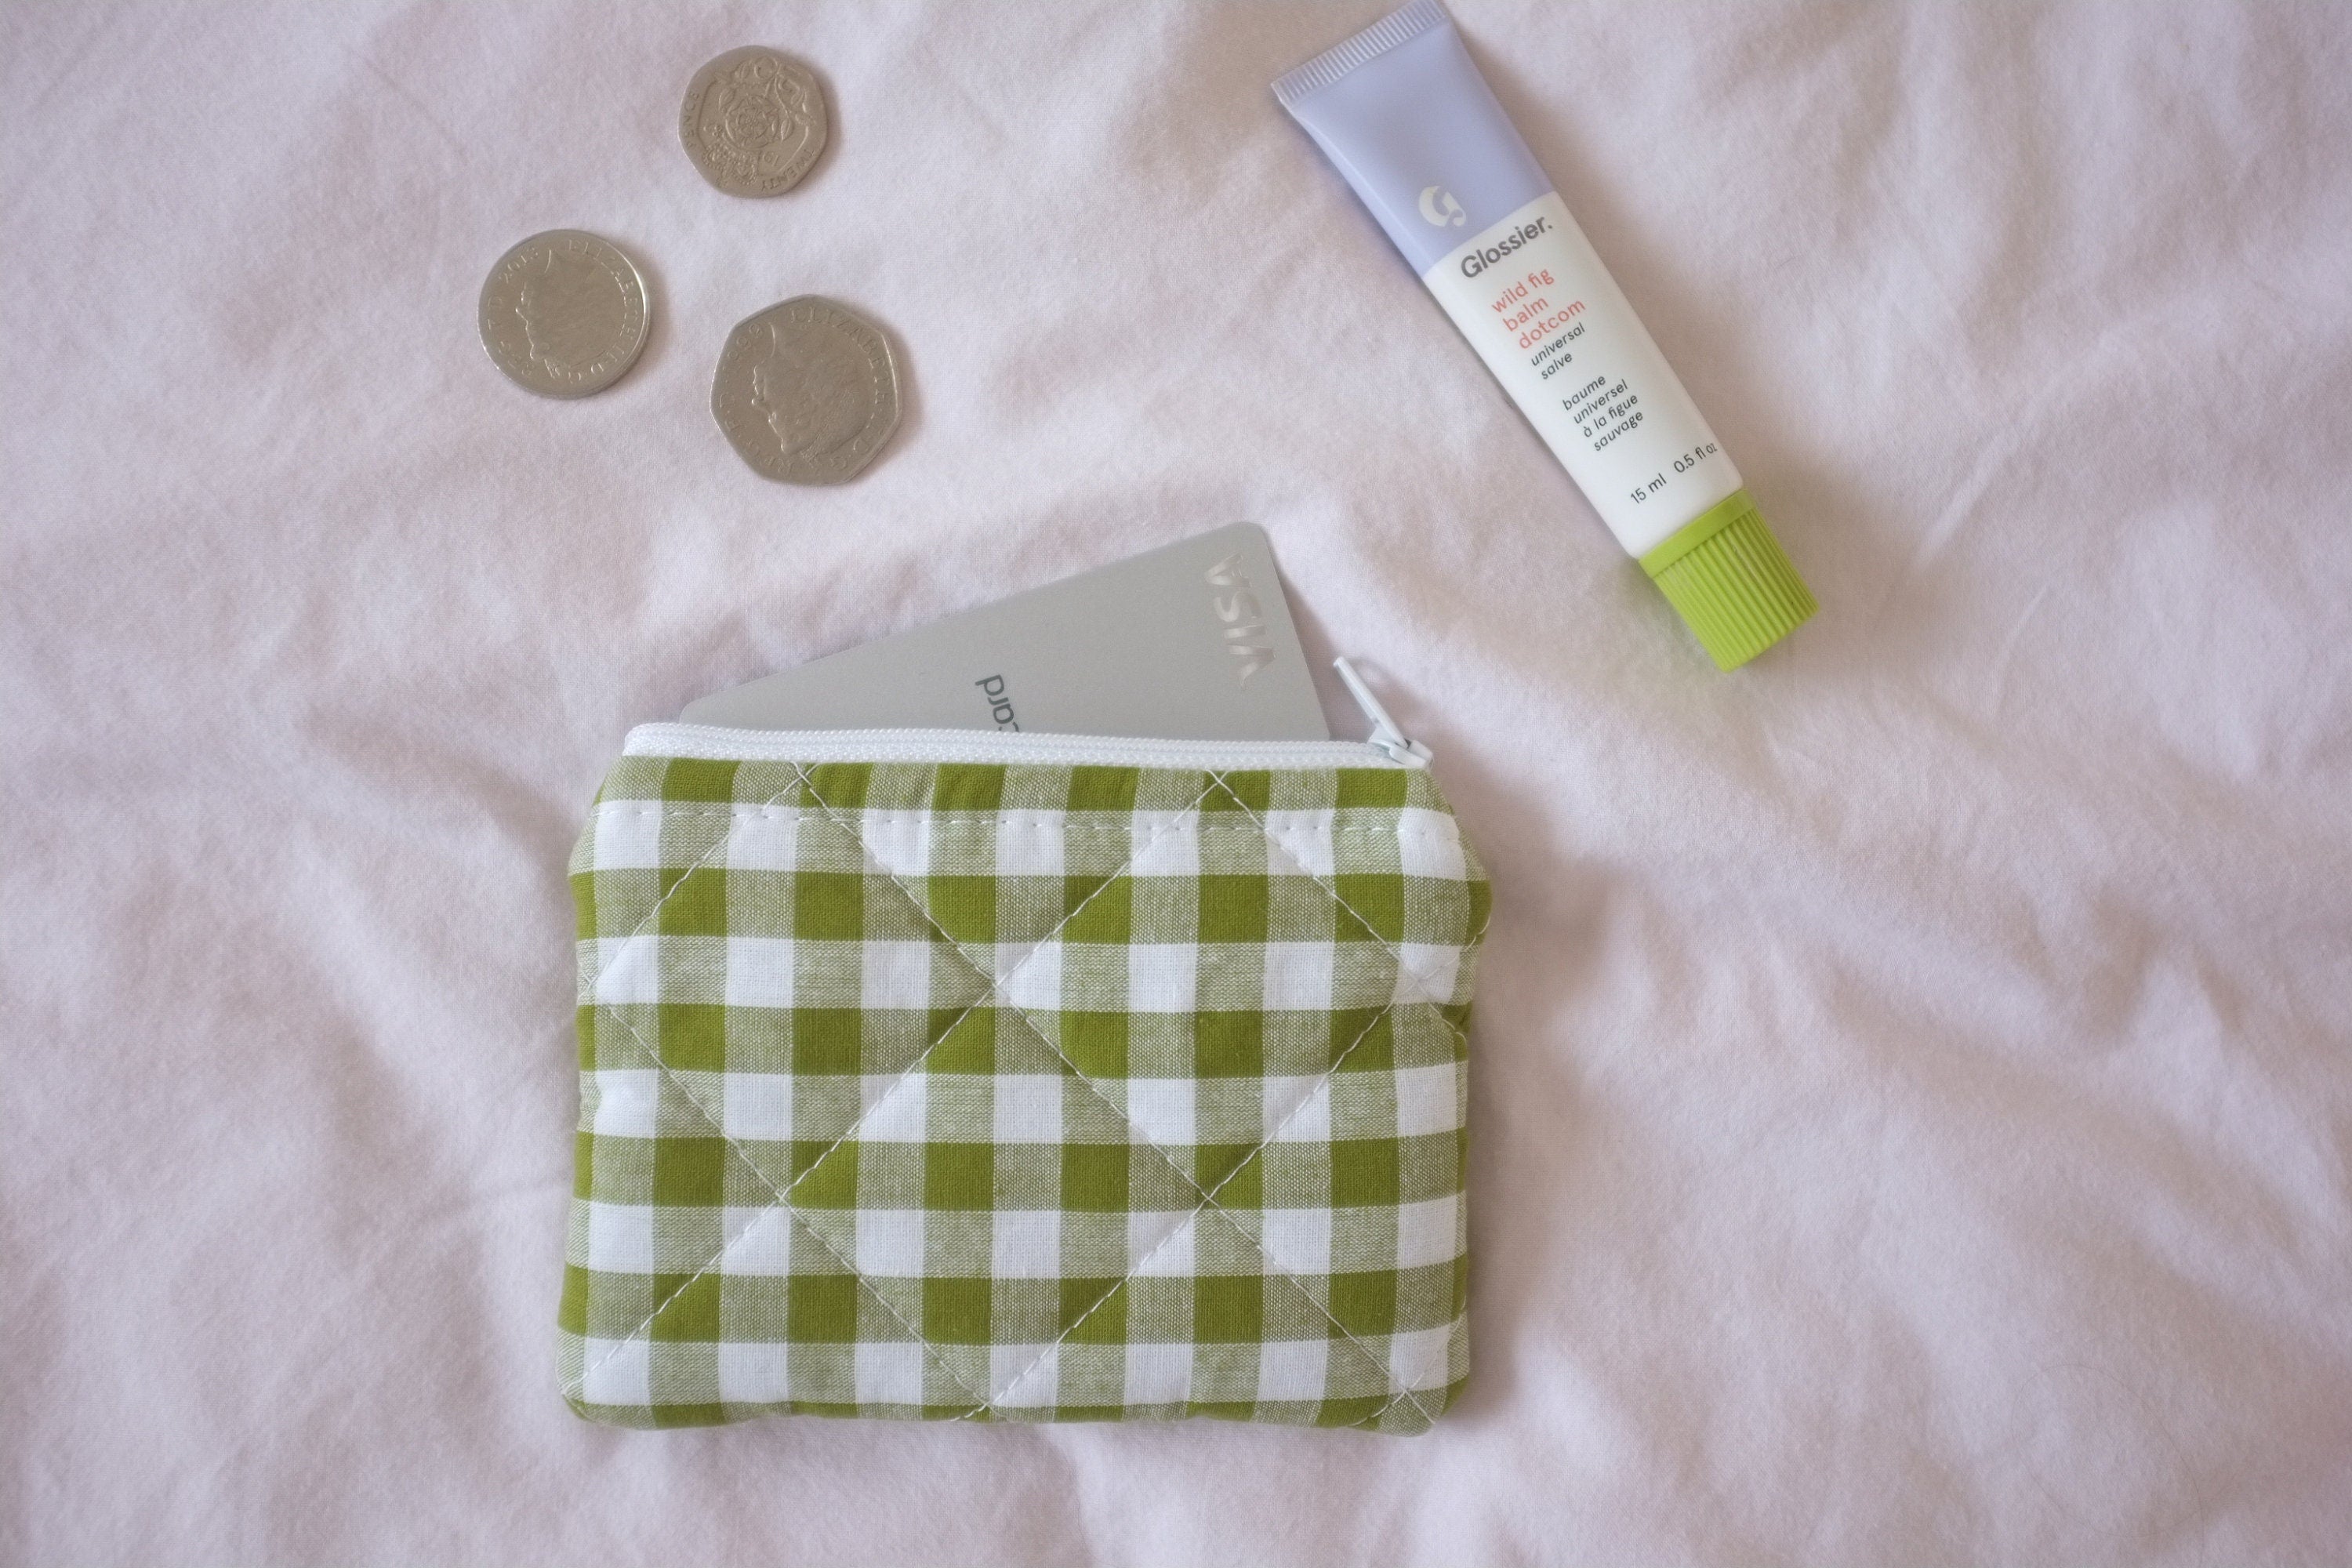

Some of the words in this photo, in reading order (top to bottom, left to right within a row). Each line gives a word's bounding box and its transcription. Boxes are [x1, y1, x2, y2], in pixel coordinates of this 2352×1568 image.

[1461, 216, 1553, 279] Glossier.
[1492, 281, 1529, 314] wild
[1529, 268, 1555, 290] fig
[1503, 296, 1549, 332] balm
[1519, 300, 1586, 350] dotcom
[1531, 322, 1586, 367] universal
[1541, 352, 1573, 380] salve
[1562, 375, 1606, 412] baume
[1573, 379, 1628, 425] universel
[1583, 426, 1593, 438] à
[1593, 416, 1608, 430] la
[1608, 394, 1639, 419] figue
[1594, 410, 1644, 452] sauvage
[1631, 488, 1646, 504] 15
[1648, 473, 1667, 493] ml
[1674, 454, 1694, 473] 0.5
[1695, 447, 1706, 459] fl
[1706, 443, 1718, 454] oz
[1204, 554, 1276, 690] VISA
